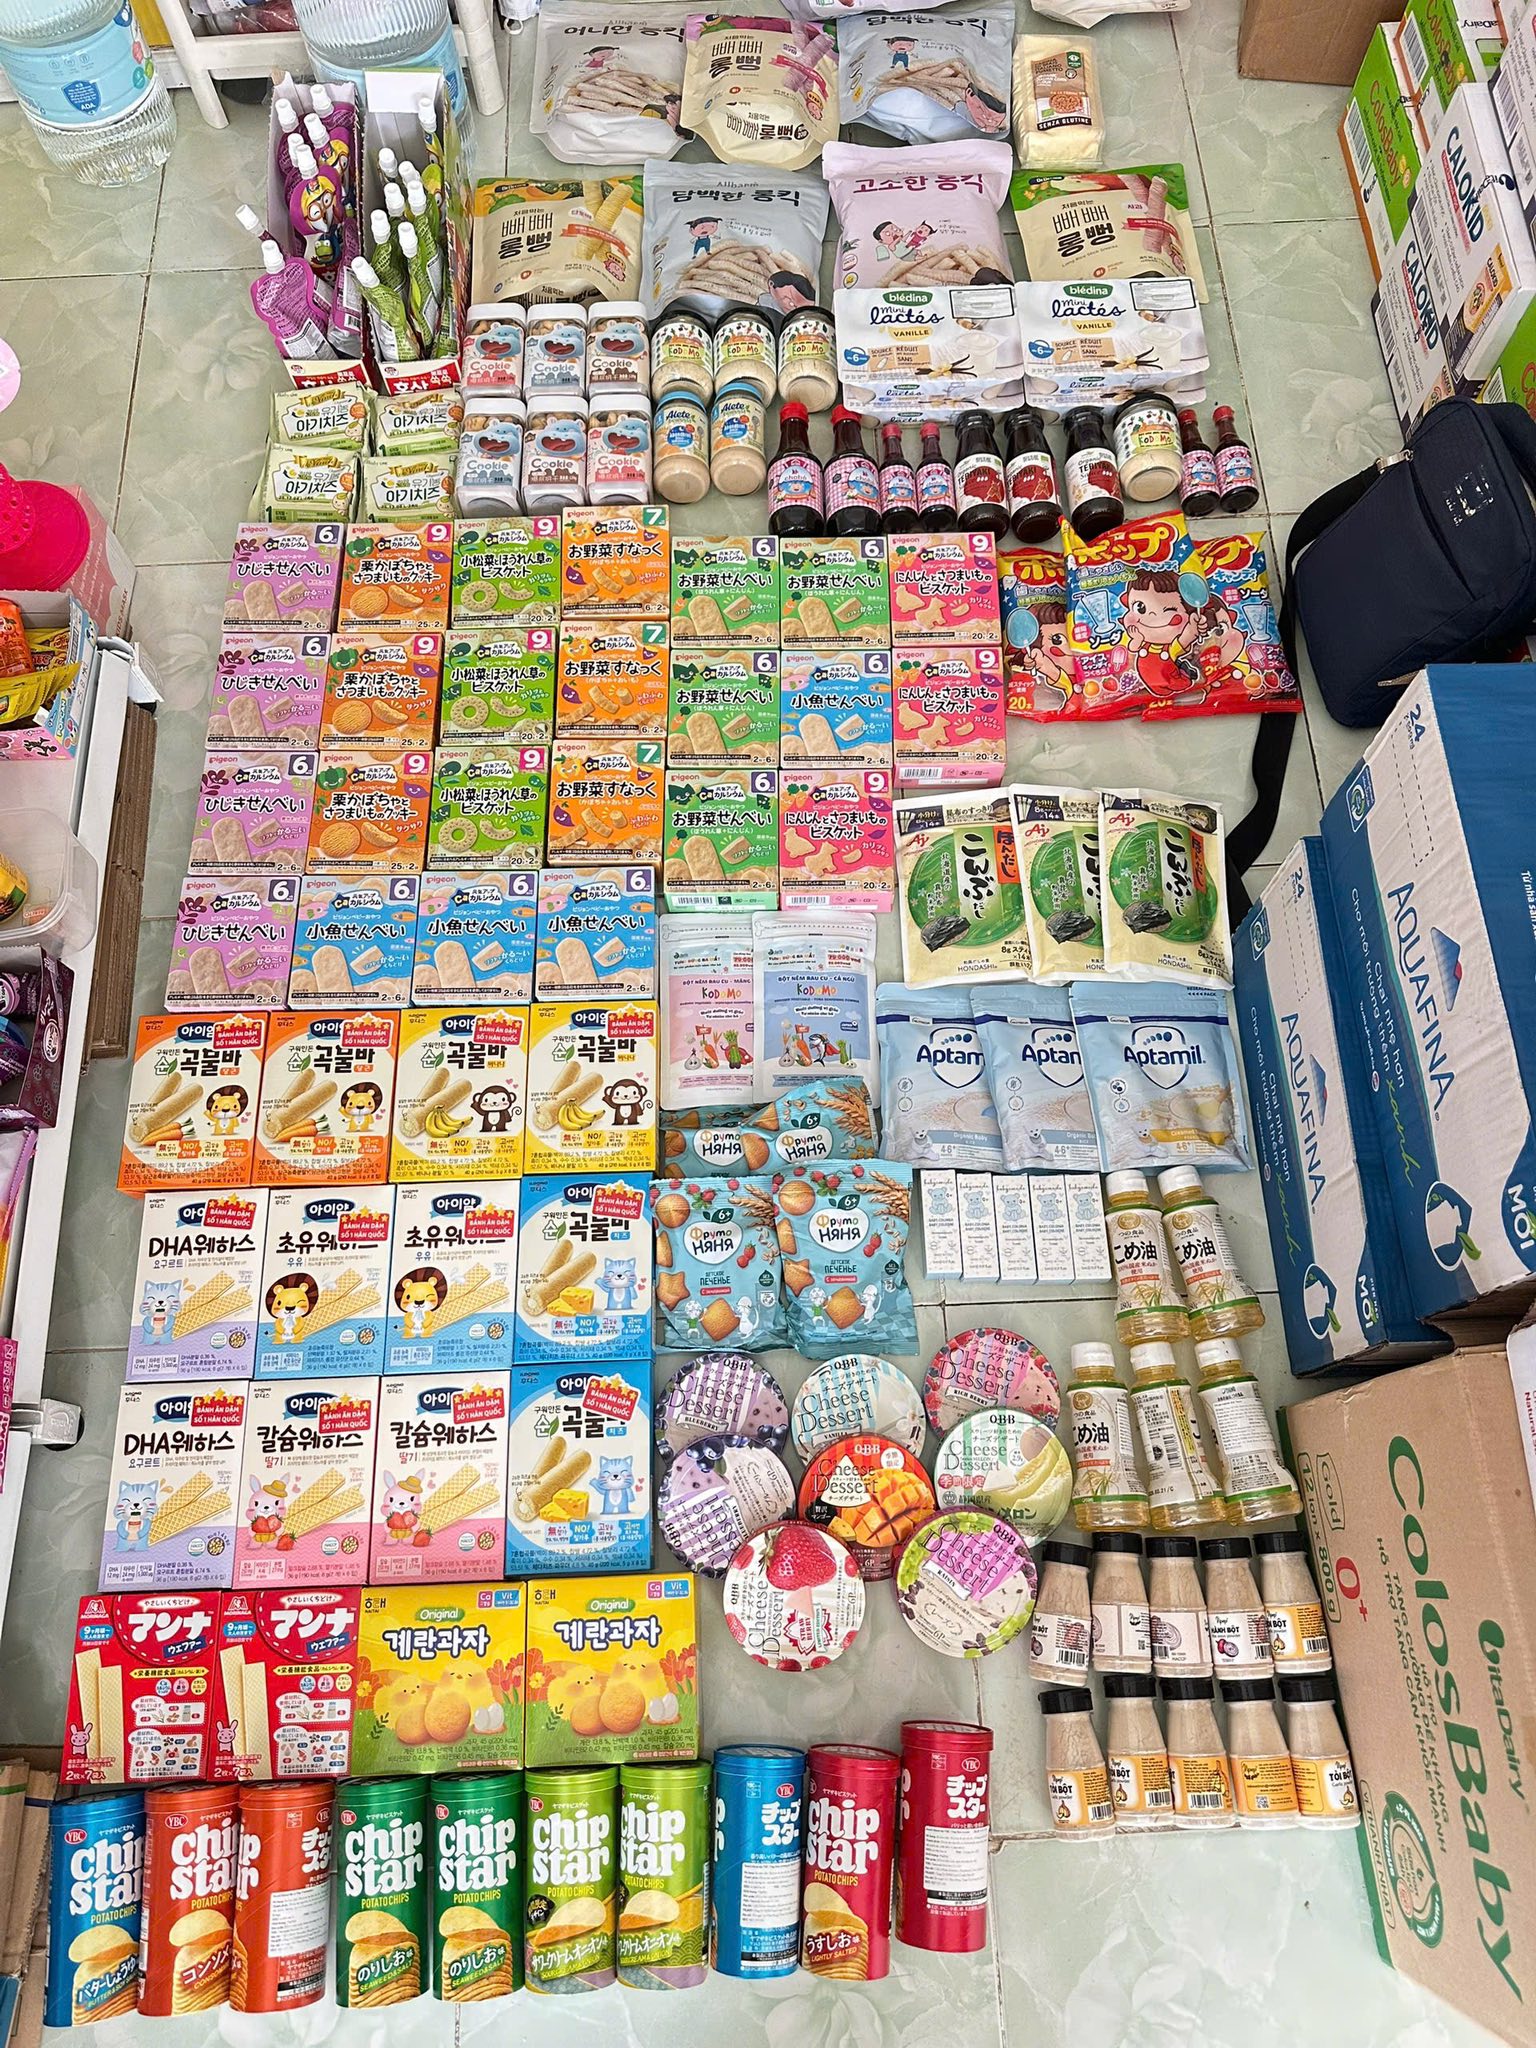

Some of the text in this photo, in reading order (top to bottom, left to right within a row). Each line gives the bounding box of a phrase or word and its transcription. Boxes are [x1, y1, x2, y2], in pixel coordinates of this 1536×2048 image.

[854, 176, 928, 193] 고소한
[1446, 126, 1484, 242] CALOKID
[889, 293, 927, 302] blédina
[1070, 287, 1108, 295] blédina
[870, 307, 944, 325] lactés
[1052, 300, 1126, 318] lactés
[1077, 322, 1112, 330] VANILLE
[470, 362, 511, 371] Cookie
[534, 363, 575, 373] Cookie
[592, 360, 632, 368] Cookie
[296, 415, 349, 432] 아기치즈
[393, 413, 447, 428] 아기치즈
[467, 461, 509, 470] Cookie
[531, 460, 573, 469] Cookie
[599, 456, 640, 466] Cookie
[569, 543, 662, 558] お野菜すなっく
[238, 563, 330, 577] ひじきせんべい
[361, 560, 434, 572] 栗かぼちゃと
[480, 567, 531, 579] ビスケット
[679, 574, 772, 588] お野菜せんべい
[788, 575, 881, 589] お野菜せんべい
[920, 583, 969, 595] ビスケット
[1240, 588, 1269, 599] ソーダ
[1089, 631, 1123, 648] ソーダ
[565, 661, 661, 675] お野菜すなっく
[222, 676, 317, 691] ひじきせんべい
[344, 673, 419, 685] 栗かぼちゃと
[472, 681, 524, 693] ビスケット
[676, 688, 772, 703] お野菜せんべい
[791, 694, 882, 708] 小魚せんべい
[923, 701, 974, 713] ビスケット
[1408, 703, 1426, 744] 24
[558, 781, 656, 797] お野菜すなっく
[868, 772, 884, 790] 9
[205, 797, 304, 812] ひじきせんべい
[332, 793, 409, 806] 栗かぼちゃと
[461, 802, 514, 814] ビスケット
[673, 812, 772, 827] お野菜せんべい
[785, 811, 886, 824] にんじんとさつまいもの
[811, 826, 862, 839] ビスケット
[1164, 828, 1192, 899] こんぶ
[186, 882, 216, 890] pigeon
[306, 924, 404, 940] 小魚せんべい
[428, 920, 525, 936] 小魚せんべい
[548, 916, 645, 932] 小魚せんべい
[182, 925, 285, 942] ひじきせんべい
[1158, 958, 1192, 970] HONDASHI
[1388, 882, 1455, 1111] AQUAFINA
[180, 1049, 241, 1076] 곡물바
[314, 1047, 375, 1074] 곡물바
[916, 1045, 985, 1066] Aptam
[1281, 1013, 1327, 1205] AQUAFINA
[149, 1234, 255, 1257] DHA웨하스
[668, 1389, 739, 1423] Dessert
[802, 1390, 870, 1414] Cheese
[798, 1403, 874, 1433] Dessert
[390, 1421, 497, 1448] 칼슘웨하스
[124, 1431, 235, 1456] DHA웨하스
[948, 1440, 1007, 1456] Cheese
[944, 1454, 1000, 1471] Dessert
[1322, 1462, 1342, 1523] Gold
[1303, 1466, 1315, 1498] 12
[1319, 1546, 1334, 1592] 800
[590, 1599, 629, 1612] Original
[748, 1579, 768, 1648] Cheese
[419, 1608, 459, 1620] Original
[128, 1611, 211, 1641] マンナ
[270, 1608, 354, 1638] マンナ
[762, 1590, 784, 1657] Dessert
[554, 1616, 661, 1651] 계란과자
[383, 1626, 490, 1660] 계란과자
[1388, 1435, 1524, 2005] ColosBaby
[946, 1774, 987, 1797] チップ
[946, 1797, 986, 1820] スター
[808, 1798, 880, 1842] chip
[439, 1813, 516, 1859] chip
[532, 1810, 609, 1853] chip
[345, 1818, 424, 1863] chip
[806, 1830, 879, 1875] star
[439, 1848, 516, 1894] star
[532, 1843, 609, 1885] star
[345, 1848, 424, 1897] star
[814, 1870, 859, 1886] POTATO CHIPS
[547, 1884, 594, 1897] POTATO CHIPS
[191, 1896, 218, 1910] POTATO
[90, 1904, 137, 1924] POTATO CHIPS
